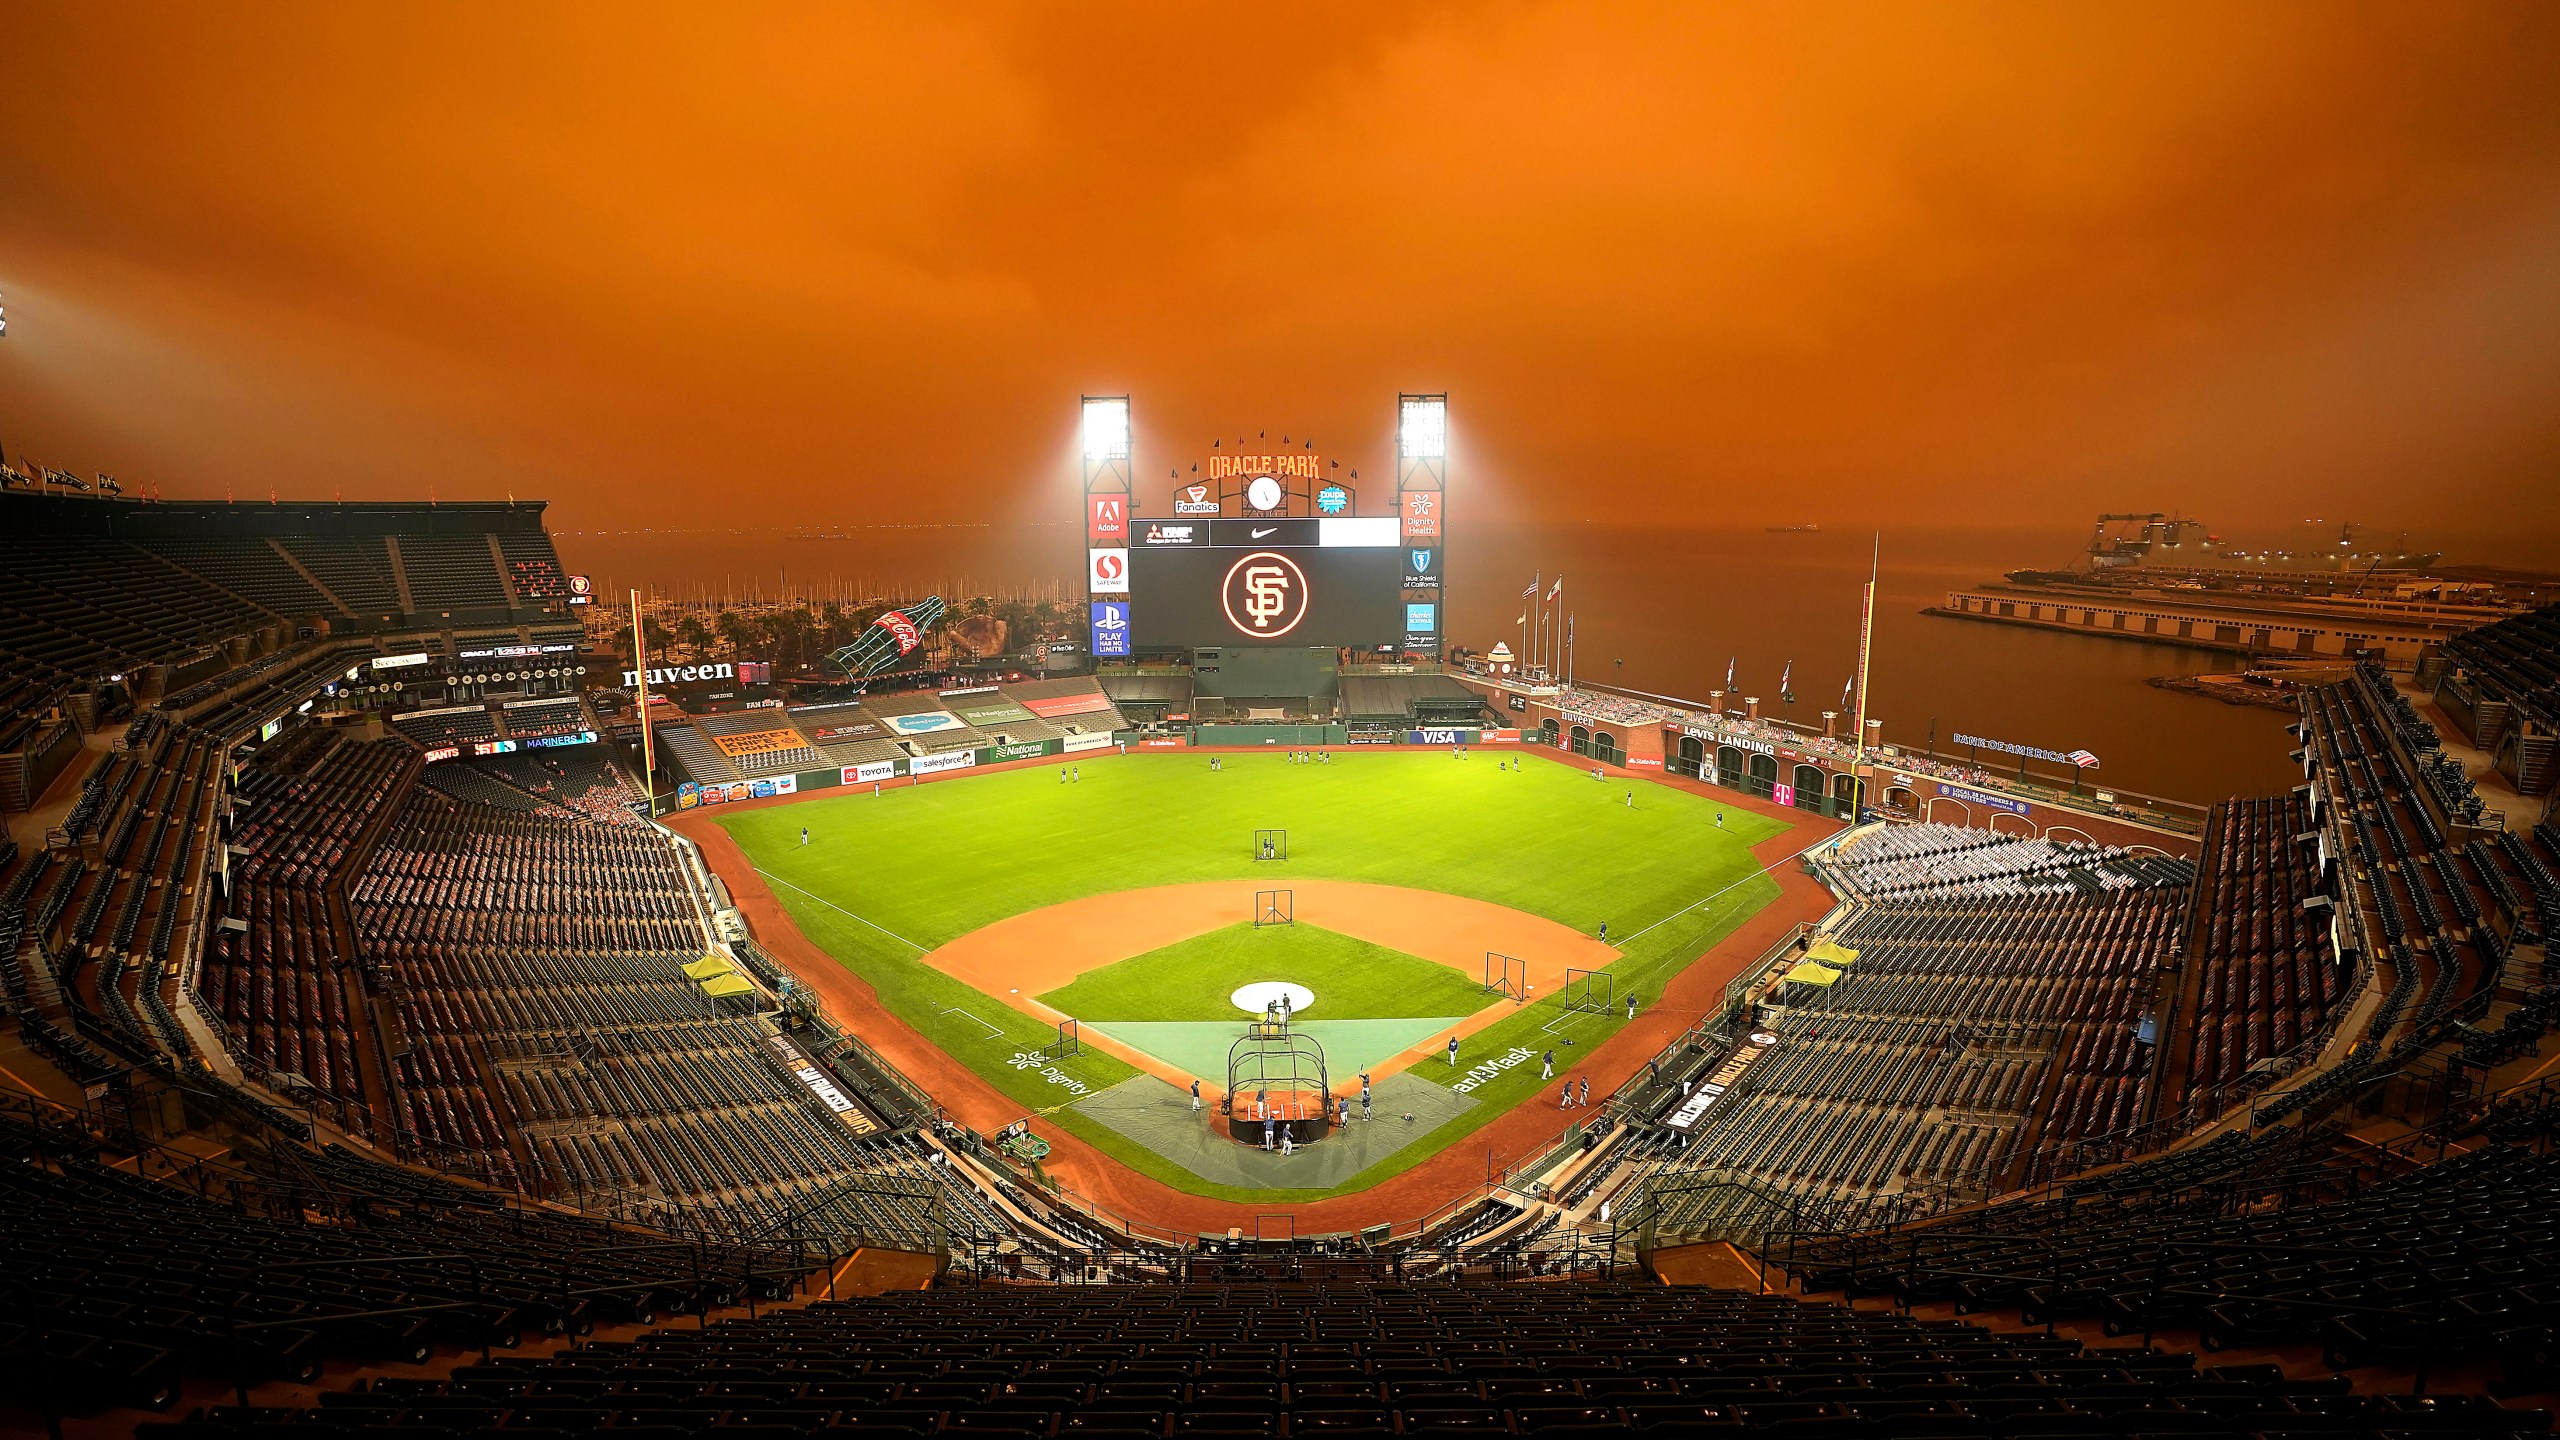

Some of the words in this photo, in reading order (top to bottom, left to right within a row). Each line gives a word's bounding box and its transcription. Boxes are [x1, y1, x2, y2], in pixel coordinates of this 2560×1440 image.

[1209, 455, 1271, 479] ORACLE
[1277, 455, 1319, 479] PARK
[1177, 502, 1218, 512] Fanatics
[1097, 523, 1119, 531] Adobe
[1407, 517, 1435, 527] Dignity
[1099, 632, 1122, 641] PLAY
[981, 707, 1021, 717] National
[903, 717, 946, 726] salesforce
[1561, 711, 1594, 727] nuveen
[527, 735, 577, 749] MARINERS
[719, 731, 791, 743] MONKEY
[724, 737, 774, 749] KNIFE
[1420, 731, 1456, 743] VISA
[728, 742, 779, 753] FIGHT
[1006, 742, 1043, 756] National
[1718, 734, 1775, 755] LANDING
[1953, 733, 1986, 748] BANK
[1988, 740, 2004, 750] OF
[2006, 743, 2066, 763] AMERICA
[427, 748, 459, 763] GIANTS
[923, 755, 962, 768] salesforce
[860, 766, 892, 777] TOYOTA
[1952, 788, 1971, 796] LOCAL
[1980, 794, 2009, 806] PLUMBERS
[1952, 792, 1987, 804] PIPEFITTERS
[1841, 812, 1852, 820] 309
[1732, 1045, 1763, 1064] PARK
[796, 1066, 823, 1083] SAN
[1710, 1061, 1749, 1087] ORACLE
[1039, 1067, 1092, 1095] Dignity
[806, 1078, 855, 1113] FRANCISCO
[1700, 1083, 1725, 1096] TO
[1666, 1092, 1717, 1128] WELCOME
[839, 1108, 878, 1135] GIANTS
